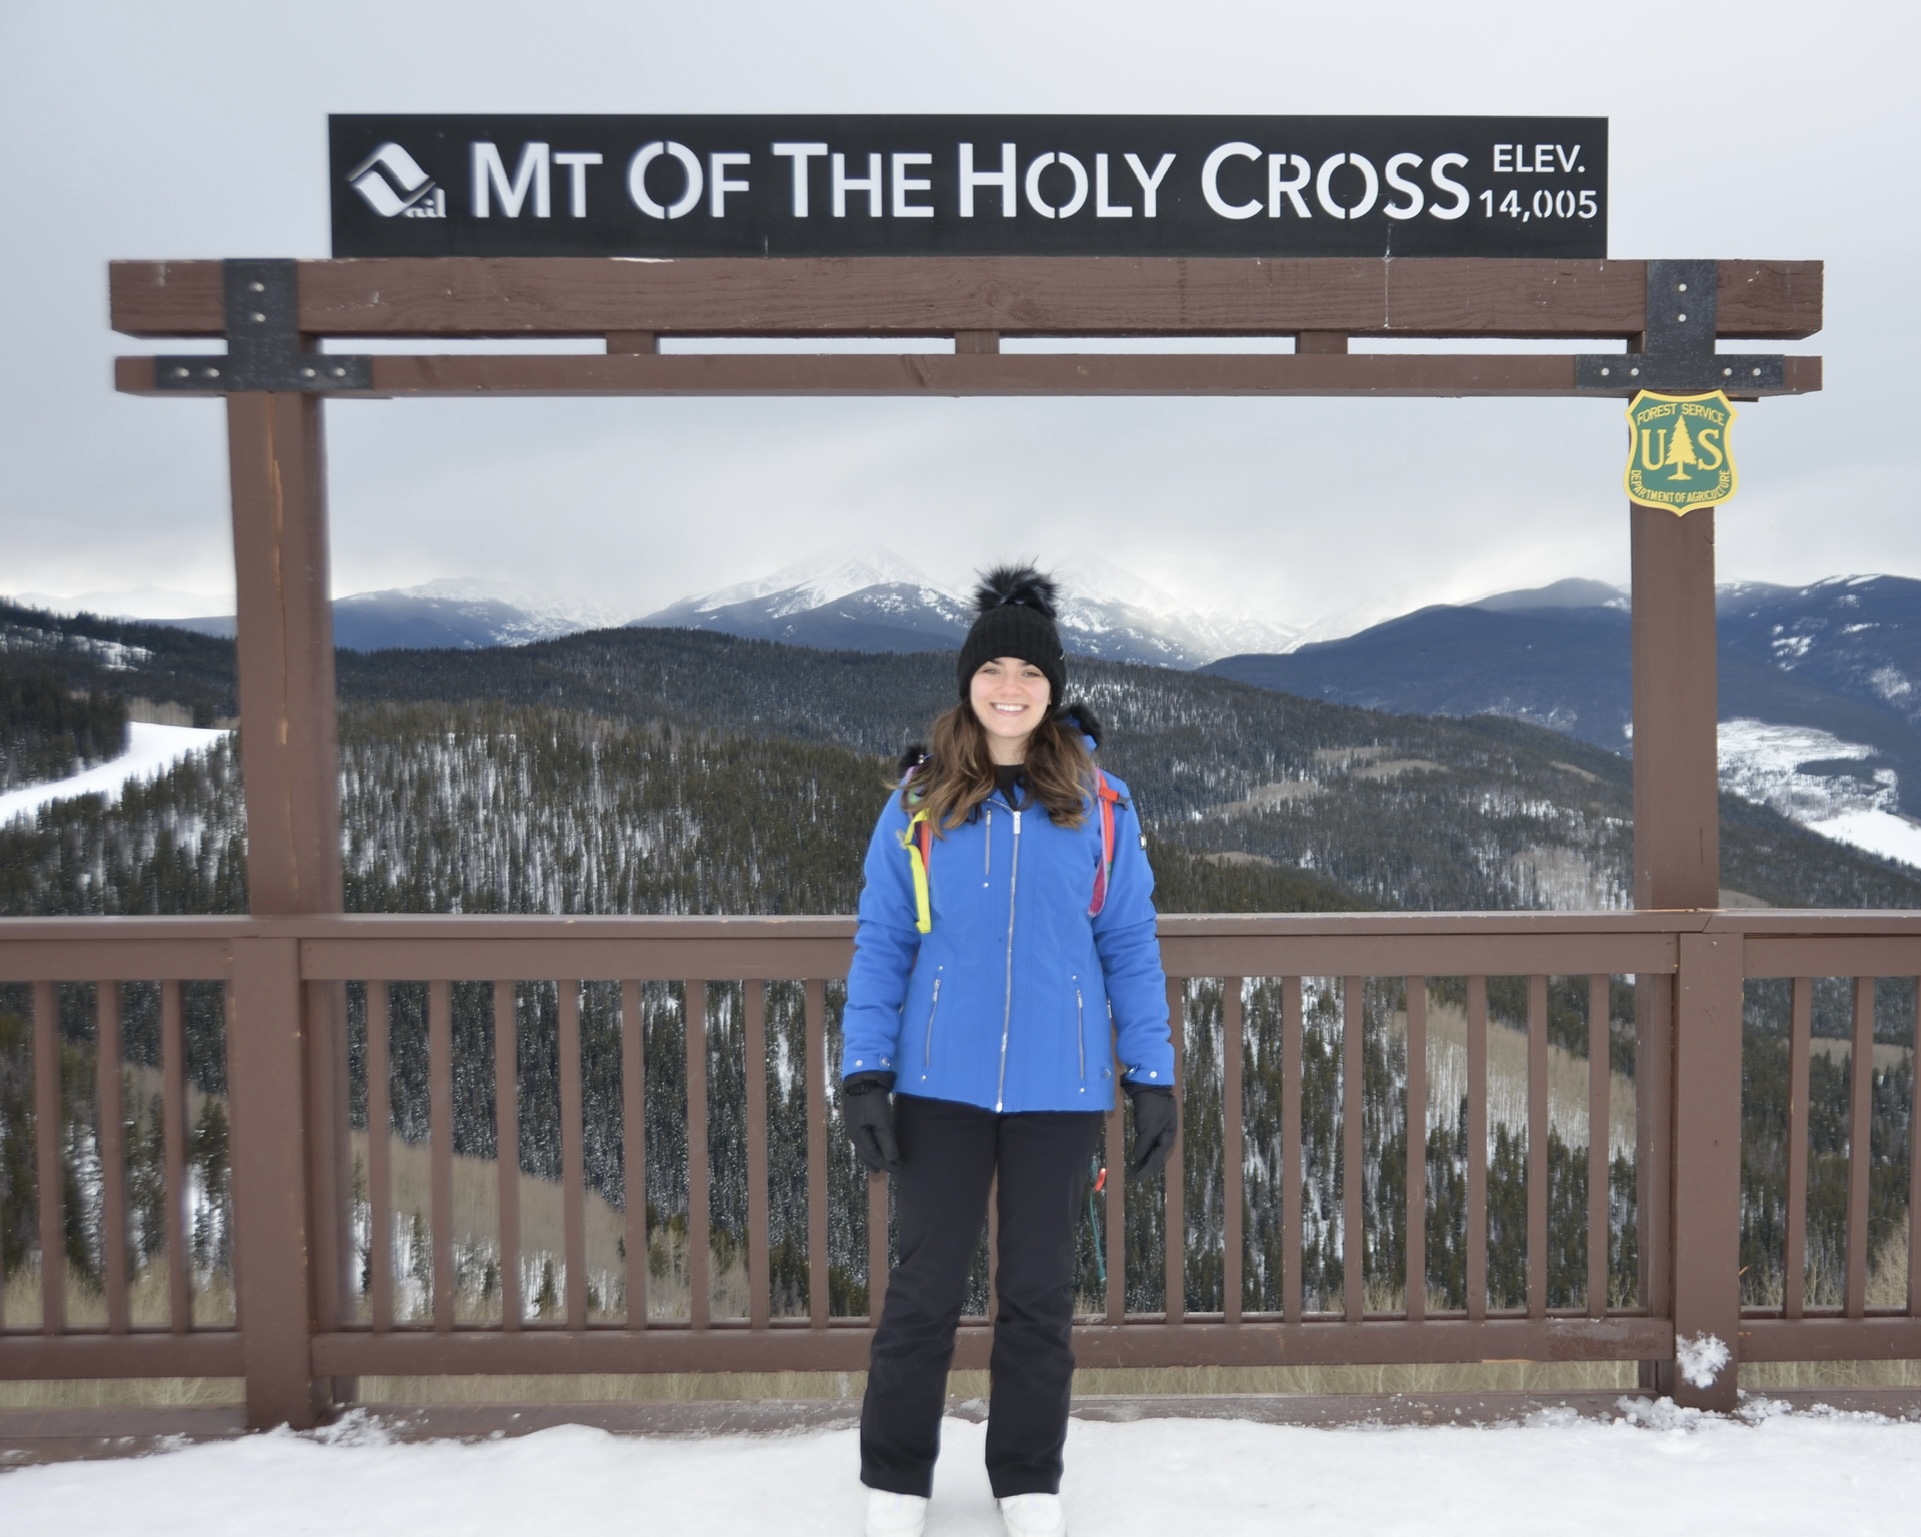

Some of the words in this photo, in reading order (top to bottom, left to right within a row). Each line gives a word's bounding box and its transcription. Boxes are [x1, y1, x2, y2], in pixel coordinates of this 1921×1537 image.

[1493, 144, 1586, 173] ELEV.
[1479, 189, 1598, 222] 14,005
[1637, 403, 1677, 425] FOREST
[1681, 403, 1725, 426] SERVICE
[1631, 469, 1675, 503] DEPARTMENT
[1675, 492, 1687, 503] OF
[1687, 469, 1731, 503] AGRICULTURE
